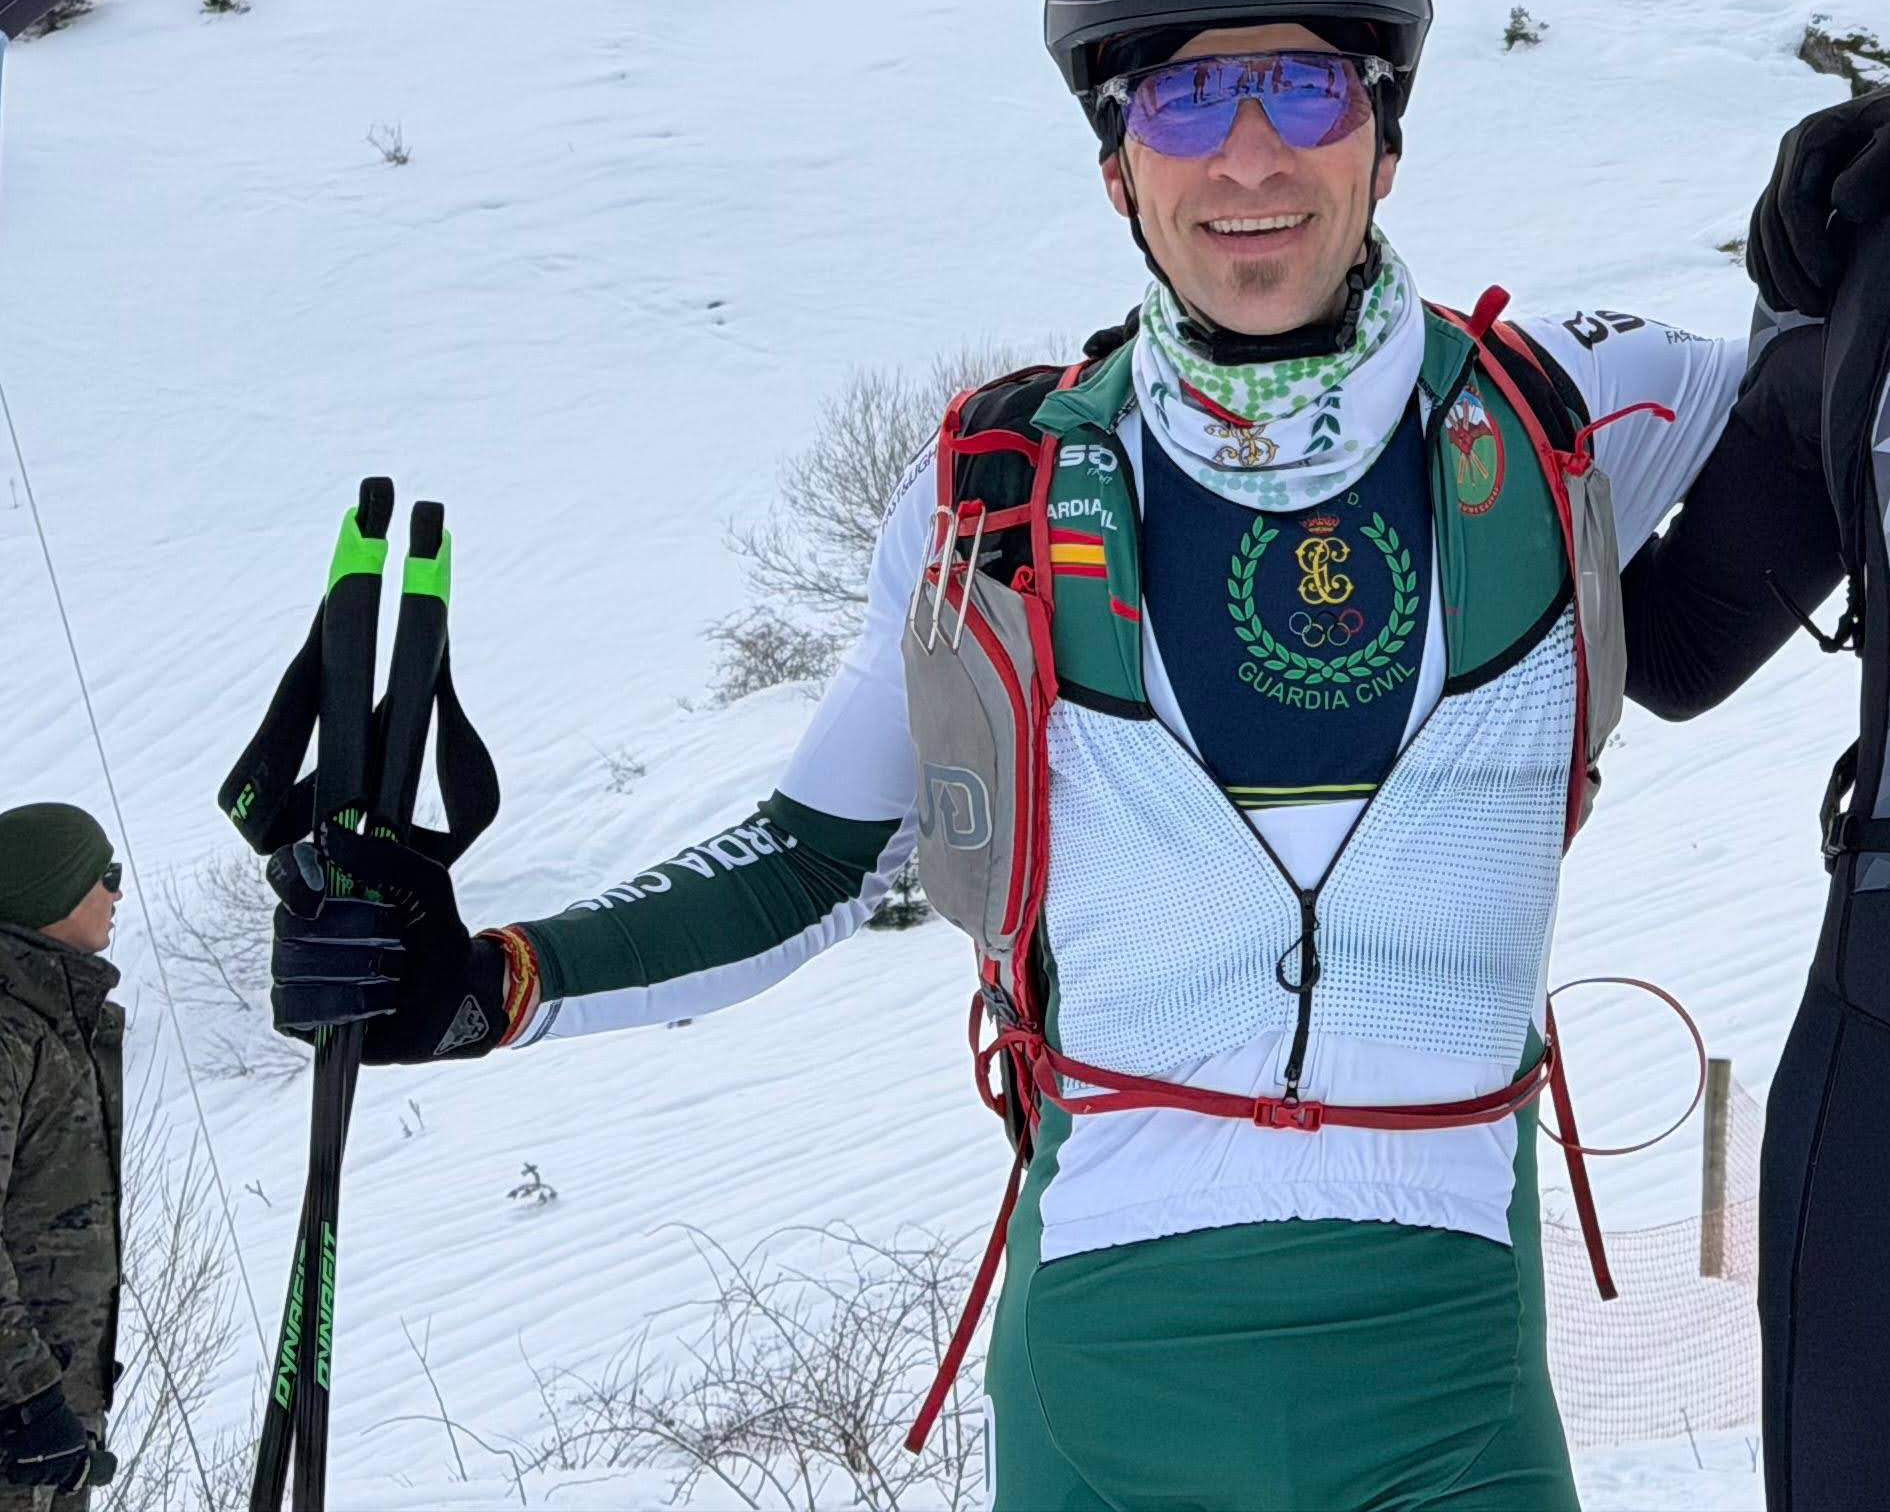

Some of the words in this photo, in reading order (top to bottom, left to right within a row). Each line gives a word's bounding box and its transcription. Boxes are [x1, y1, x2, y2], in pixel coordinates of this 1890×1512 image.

[1046, 498, 1102, 521] ARDIA
[1238, 661, 1350, 710] GUARDIA
[1356, 661, 1416, 704] CIVIL
[316, 1221, 337, 1391] DYNAFIT
